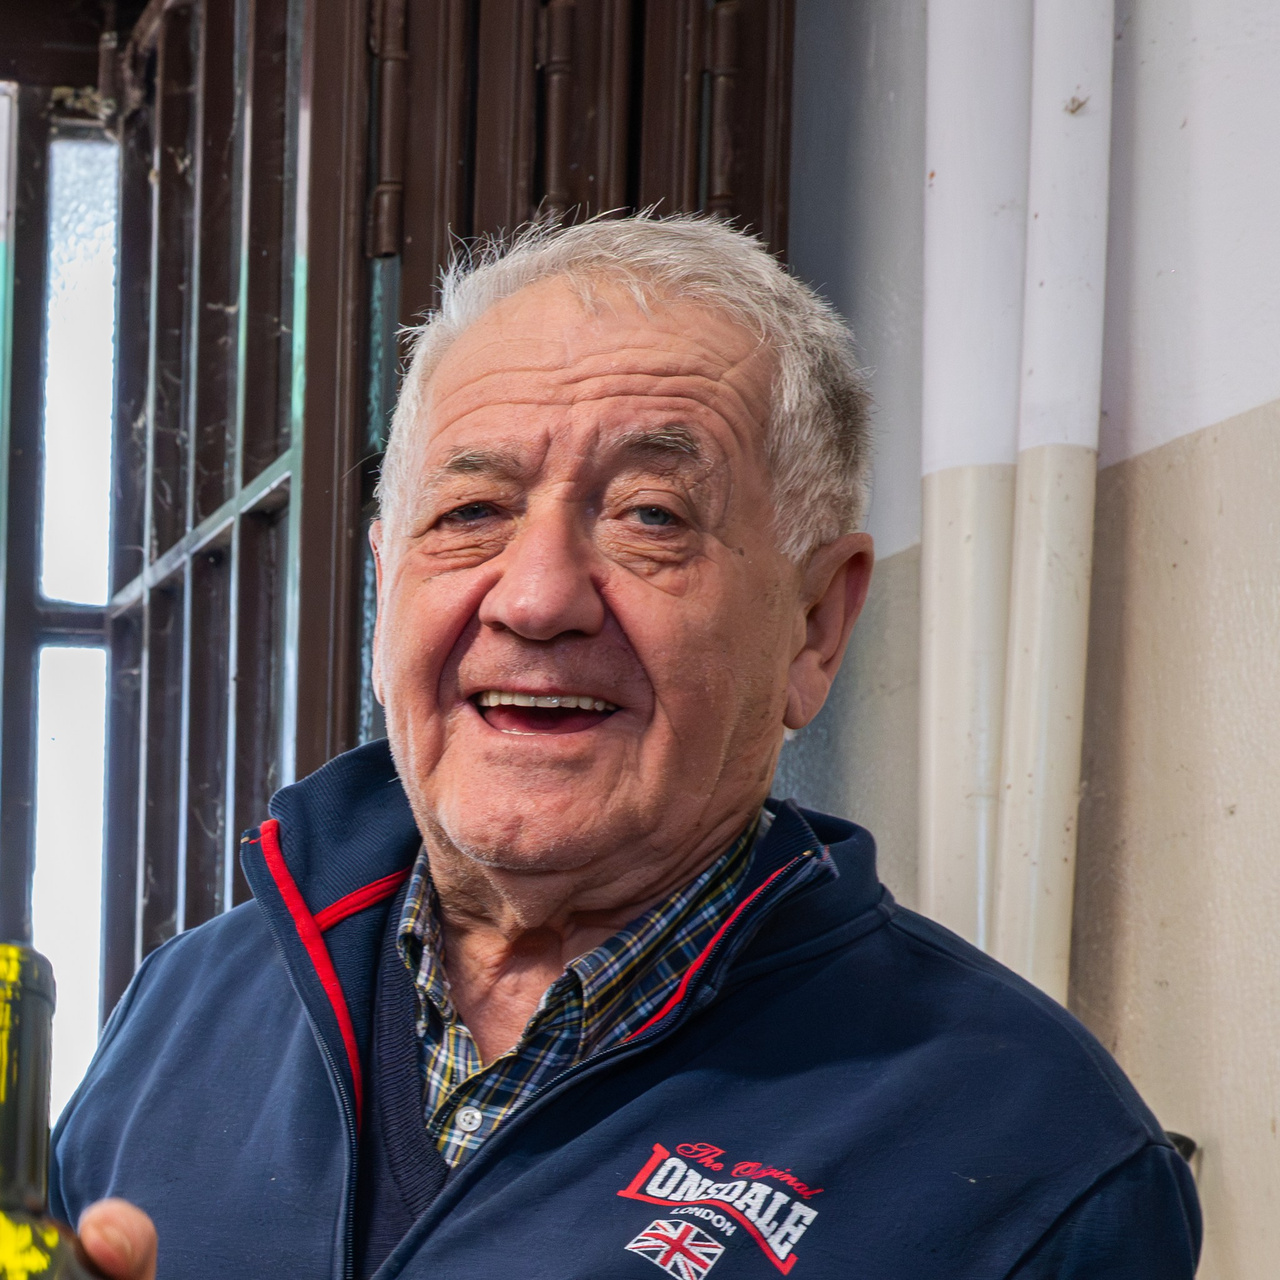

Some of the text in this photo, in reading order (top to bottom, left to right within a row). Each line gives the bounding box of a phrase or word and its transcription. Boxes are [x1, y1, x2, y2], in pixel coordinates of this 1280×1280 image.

[676, 1143, 725, 1171] The
[617, 1143, 818, 1275] LONSDALE
[670, 1206, 737, 1236] LONDON
